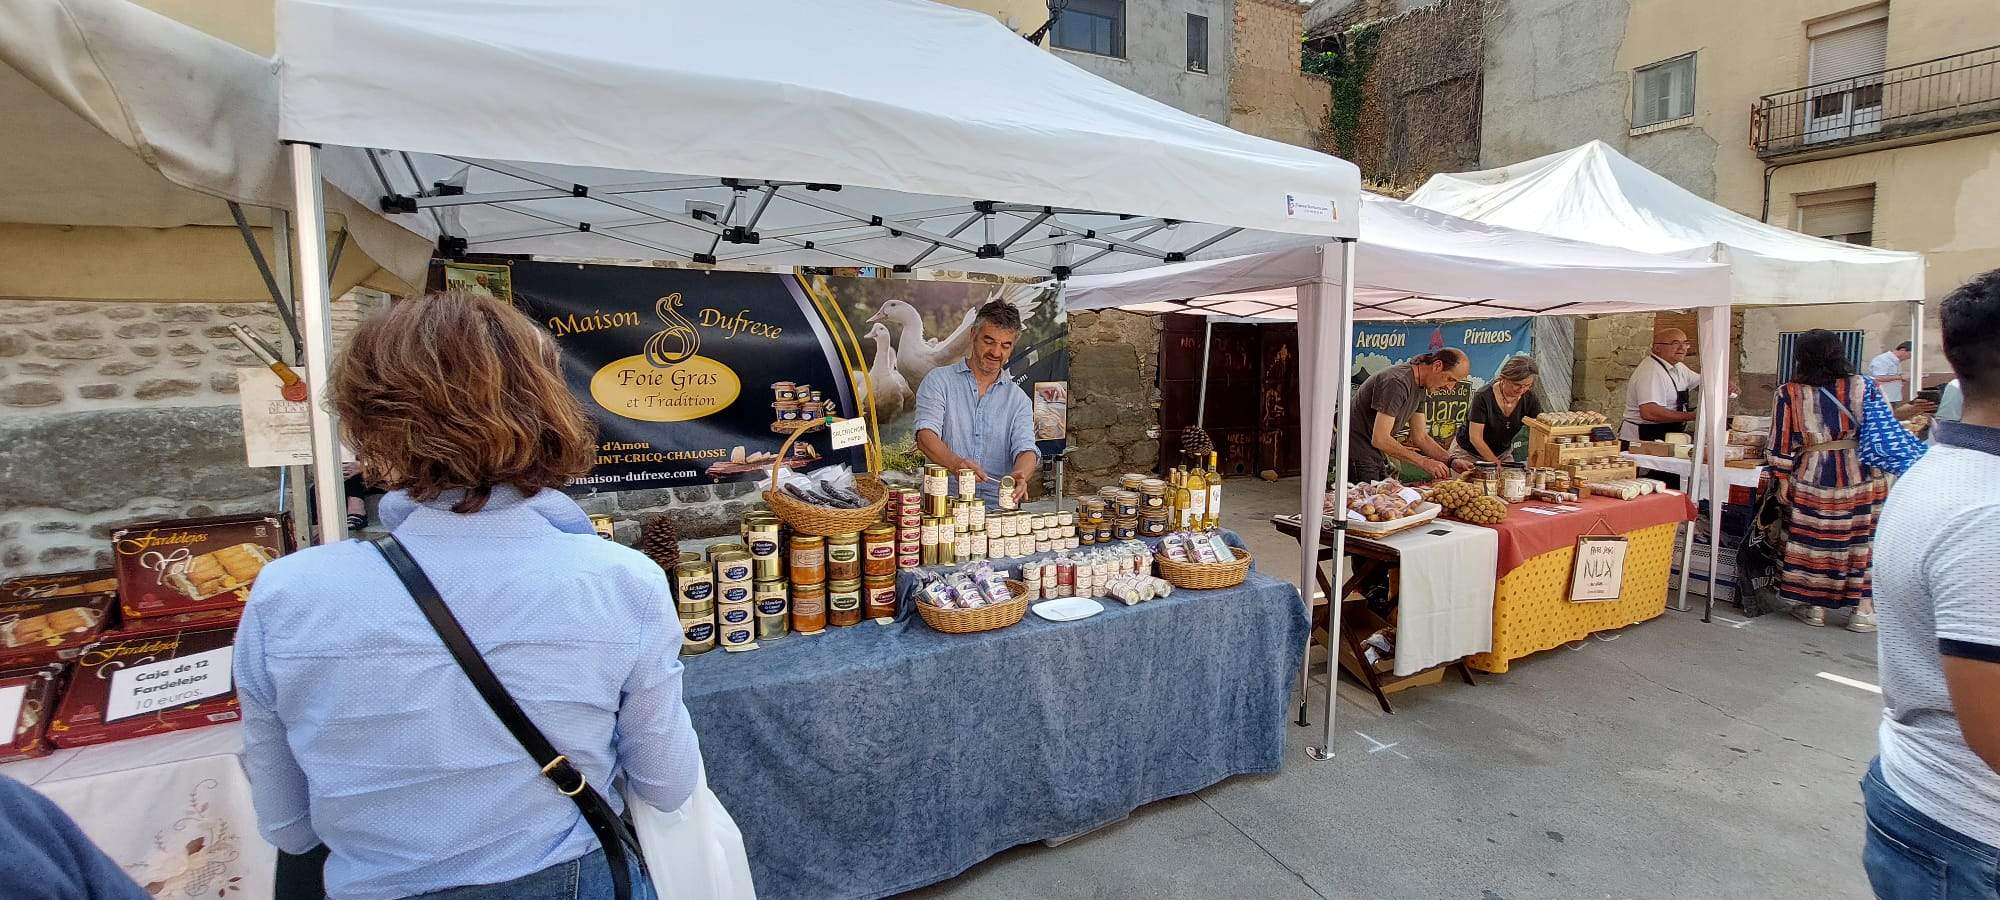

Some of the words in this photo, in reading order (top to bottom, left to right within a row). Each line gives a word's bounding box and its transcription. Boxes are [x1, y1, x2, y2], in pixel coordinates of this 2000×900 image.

[549, 309, 641, 337] Maison
[698, 307, 784, 340] Dufrexe
[1355, 329, 1407, 350] Aragón
[1462, 327, 1513, 346] Pirineos
[617, 368, 664, 387] Foie
[670, 368, 718, 391] Gras
[626, 397, 640, 409] et
[643, 391, 716, 408] Tradition
[1457, 386, 1468, 397] de
[1424, 400, 1468, 423] uara
[593, 447, 727, 466] AINT-CRICQ-CHALOSSE
[602, 440, 650, 452] d'Amou
[117, 529, 209, 555] Fardelejos
[135, 668, 170, 682] Caja
[173, 663, 192, 674] de
[195, 659, 210, 669] 12
[132, 673, 209, 696] Fardelejos
[135, 698, 153, 710] 10
